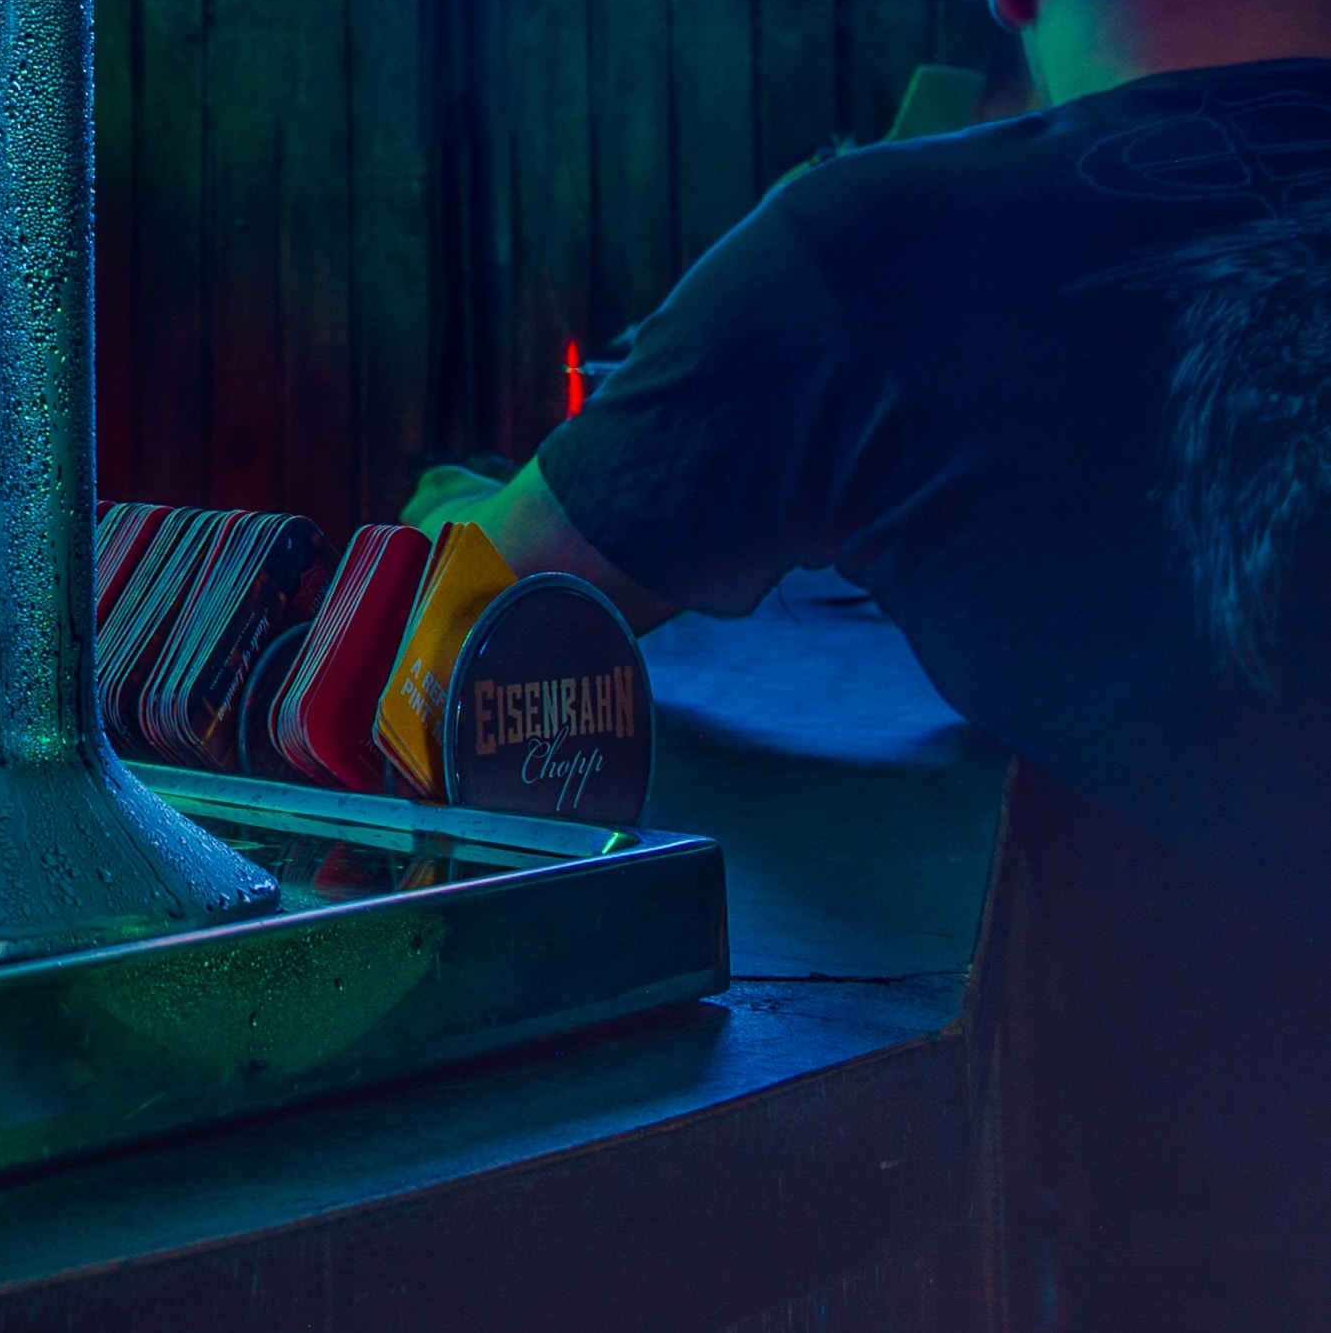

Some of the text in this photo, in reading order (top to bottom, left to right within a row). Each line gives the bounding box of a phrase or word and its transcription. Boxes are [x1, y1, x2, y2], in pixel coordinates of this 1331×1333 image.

[409, 657, 423, 680] A
[474, 665, 635, 756] EISENBAHN
[521, 724, 604, 812] Chopp
